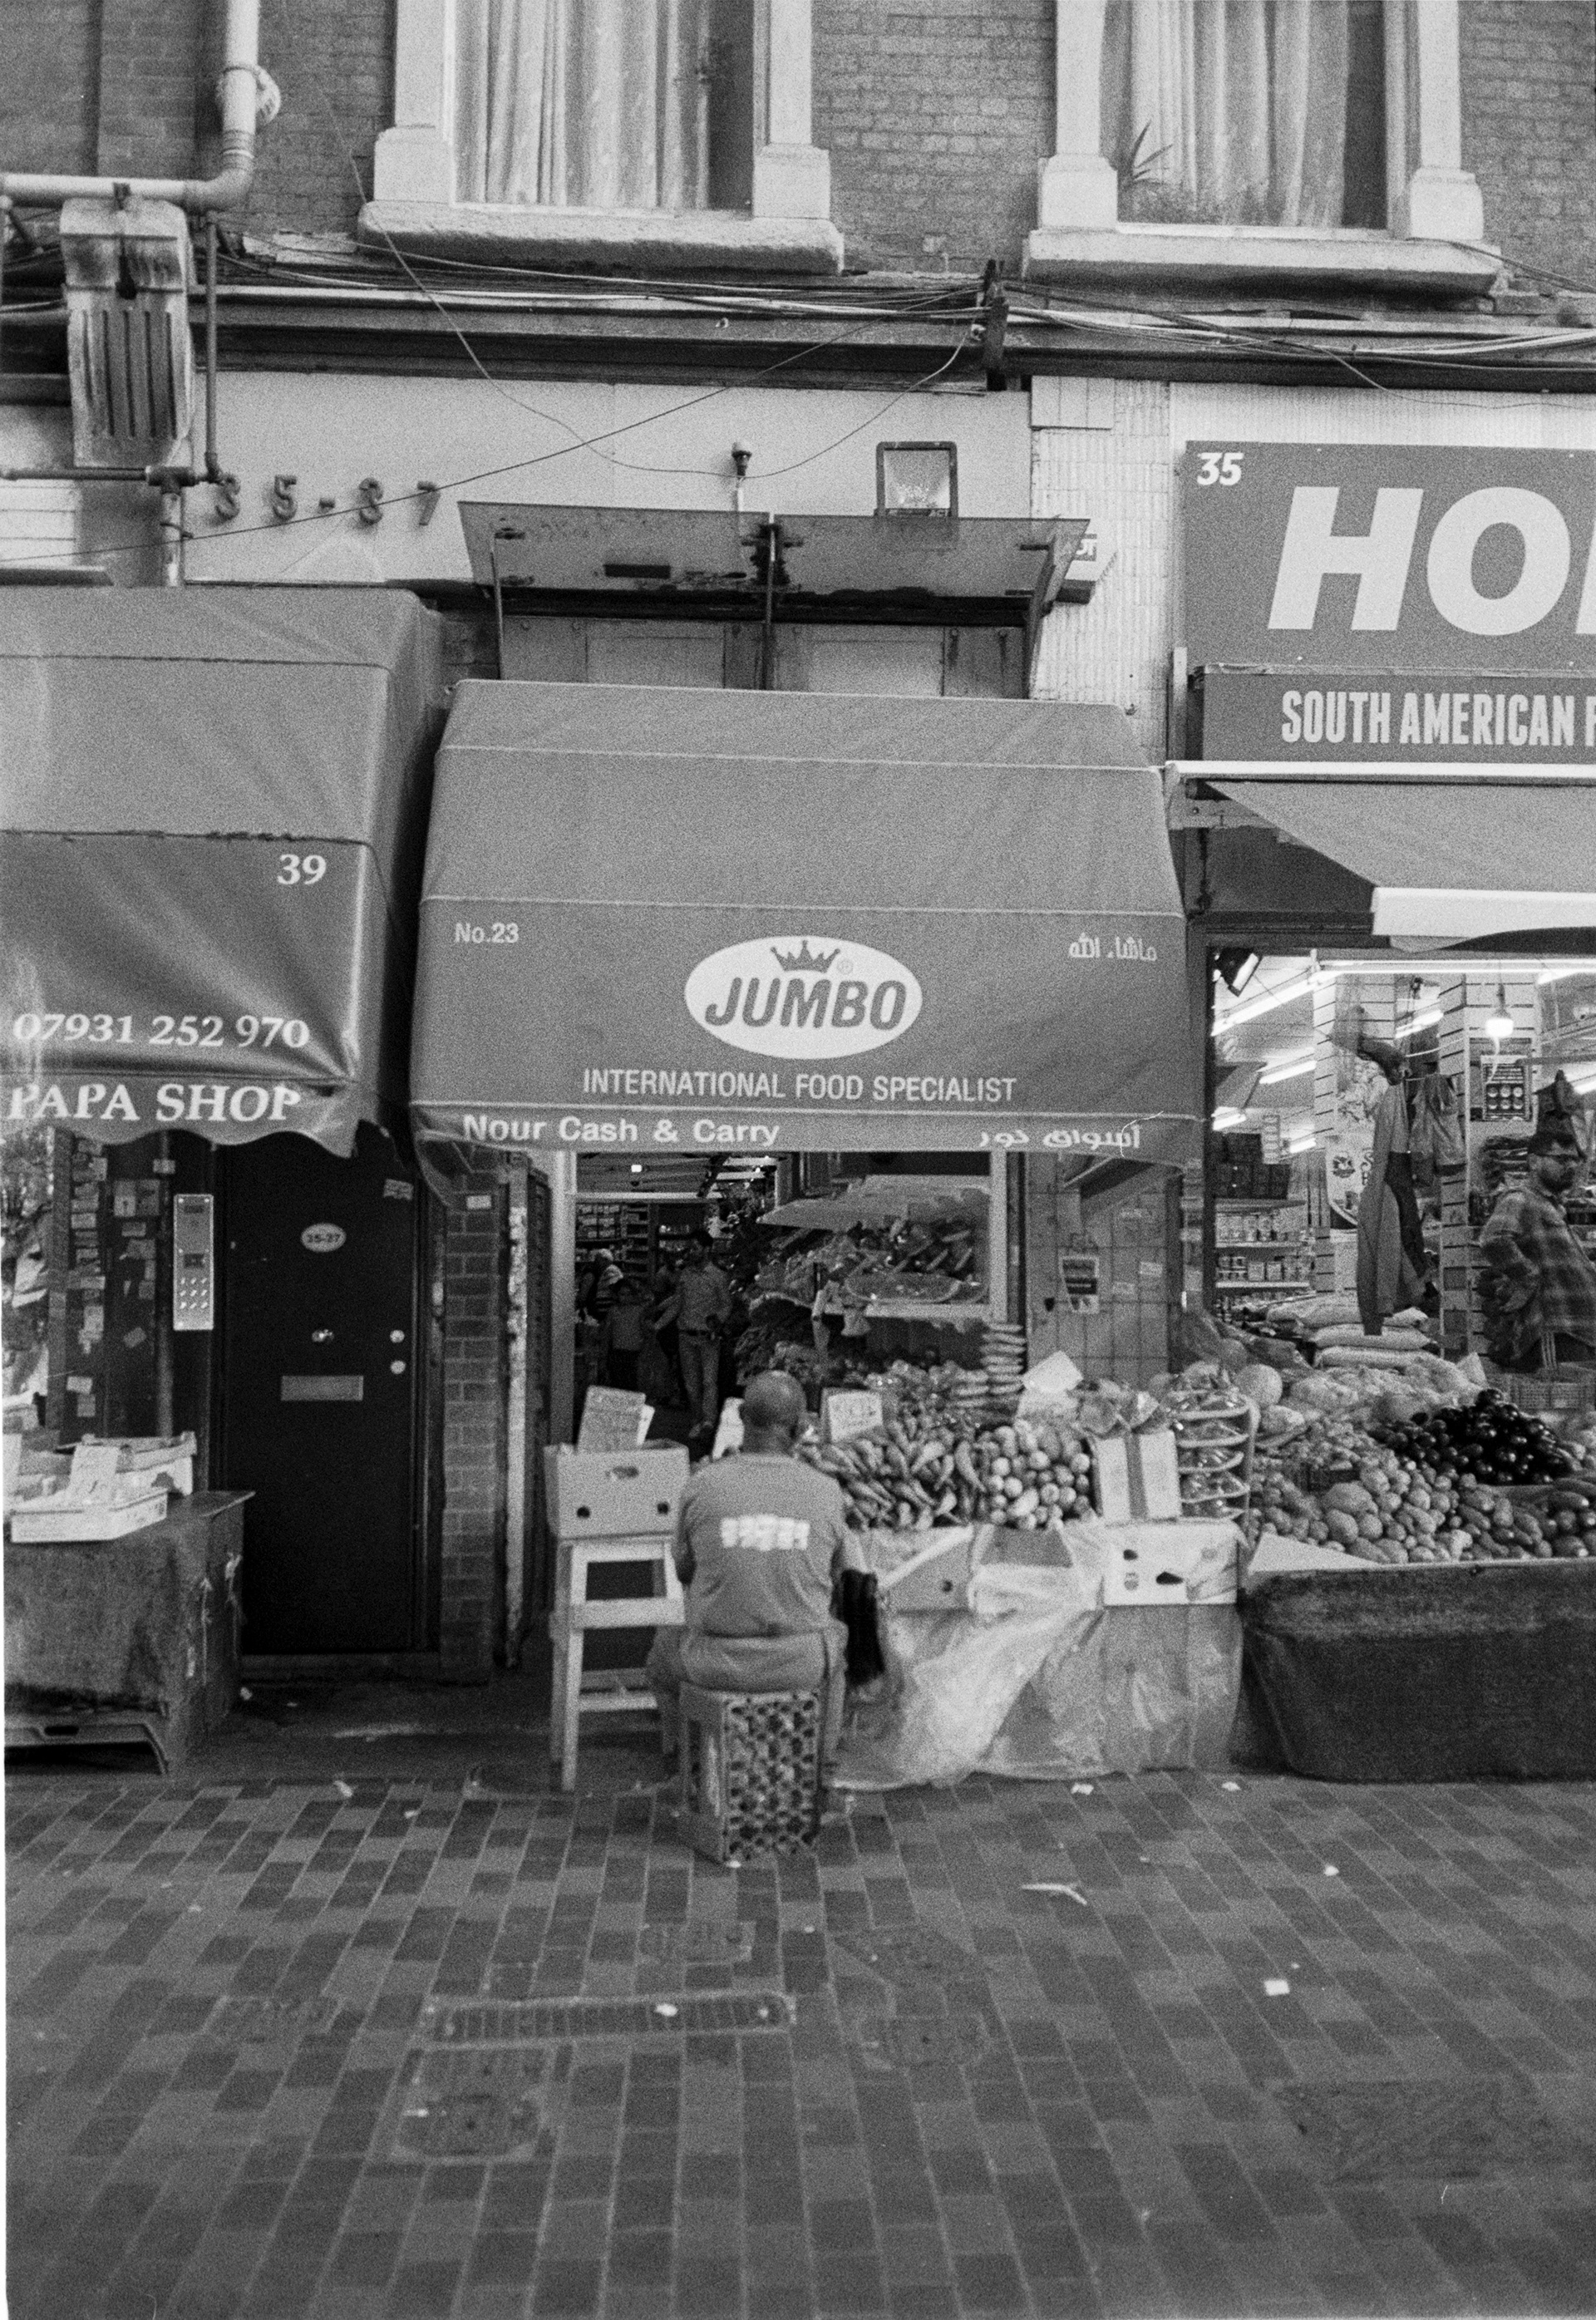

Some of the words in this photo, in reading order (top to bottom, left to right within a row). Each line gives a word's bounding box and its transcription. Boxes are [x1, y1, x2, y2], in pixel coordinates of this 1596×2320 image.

[1196, 452, 1244, 486] 35
[1267, 485, 1596, 637] HO
[1282, 690, 1391, 744] SOUTH
[1399, 692, 1575, 746] AMERICAN
[276, 855, 327, 885] 39
[454, 922, 520, 944] No.23
[704, 977, 907, 1031] JUMBO
[12, 1012, 134, 1044] 07931
[149, 1016, 224, 1047] 252
[235, 1016, 310, 1048] 970
[7, 1082, 140, 1121] PAPA
[155, 1083, 301, 1122] SHOP
[583, 1067, 786, 1098] INTERNATIONAL
[795, 1074, 864, 1101] FOOD
[872, 1076, 1017, 1103] SPECIALIST
[462, 1115, 547, 1141] Nour
[559, 1116, 638, 1141] Cash
[653, 1119, 679, 1142] &
[693, 1119, 780, 1147] Carry
